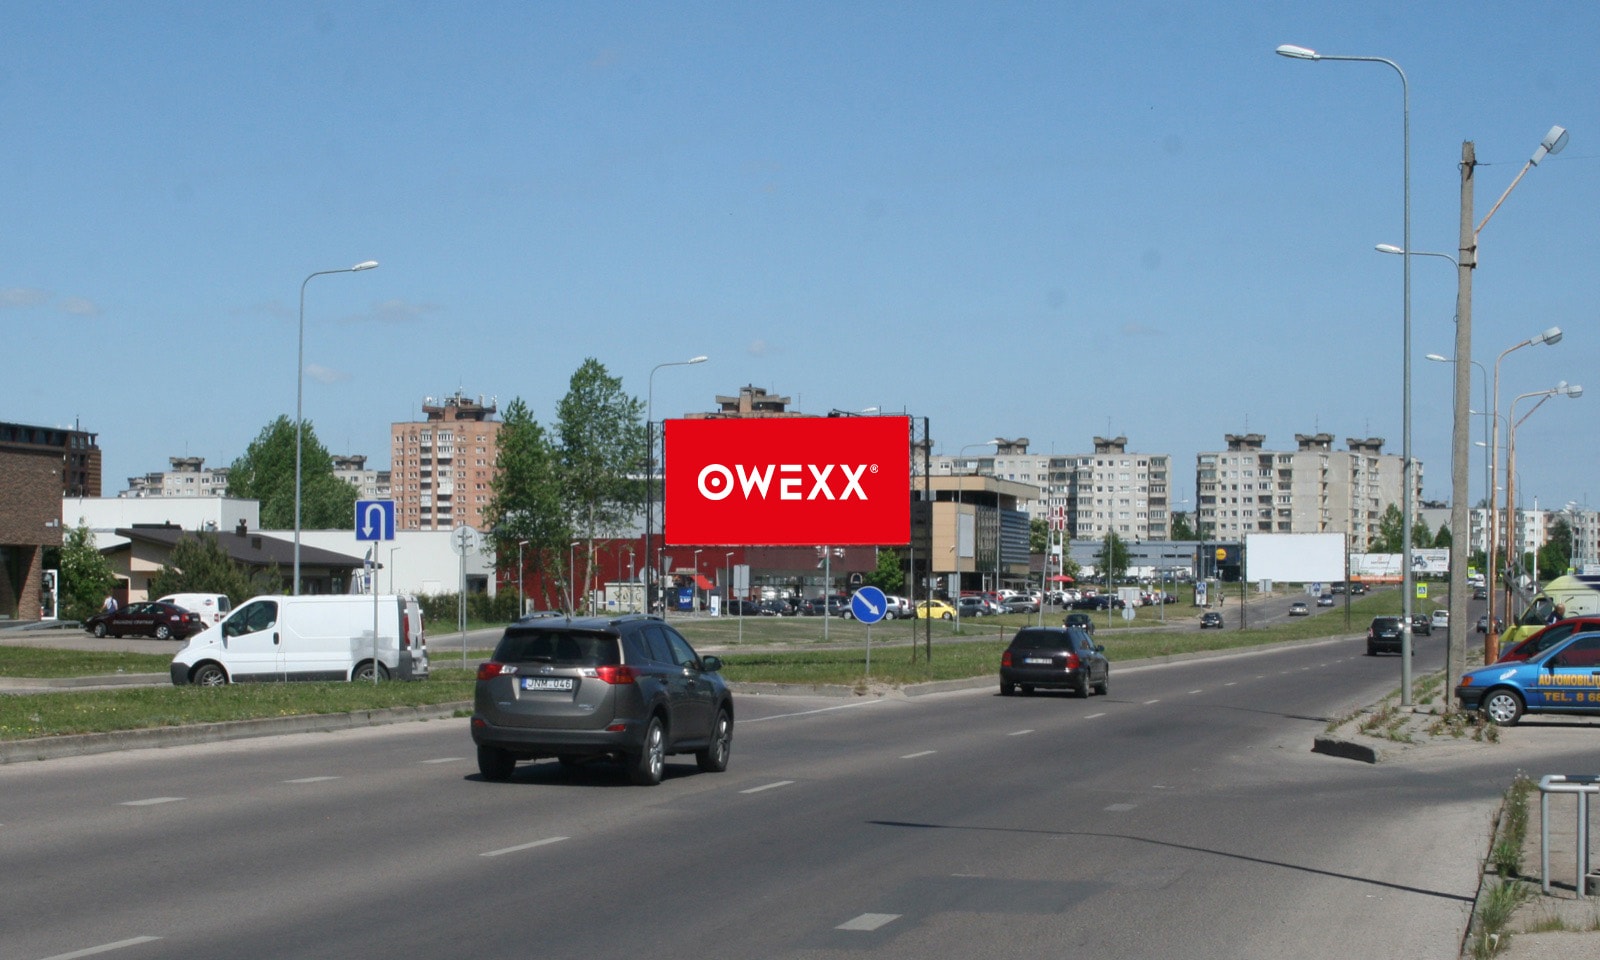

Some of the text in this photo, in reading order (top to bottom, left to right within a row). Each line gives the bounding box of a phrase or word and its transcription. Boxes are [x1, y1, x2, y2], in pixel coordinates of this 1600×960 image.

[553, 679, 571, 689] 046
[1544, 692, 1573, 702] TEL.
[1576, 692, 1585, 702] 8
